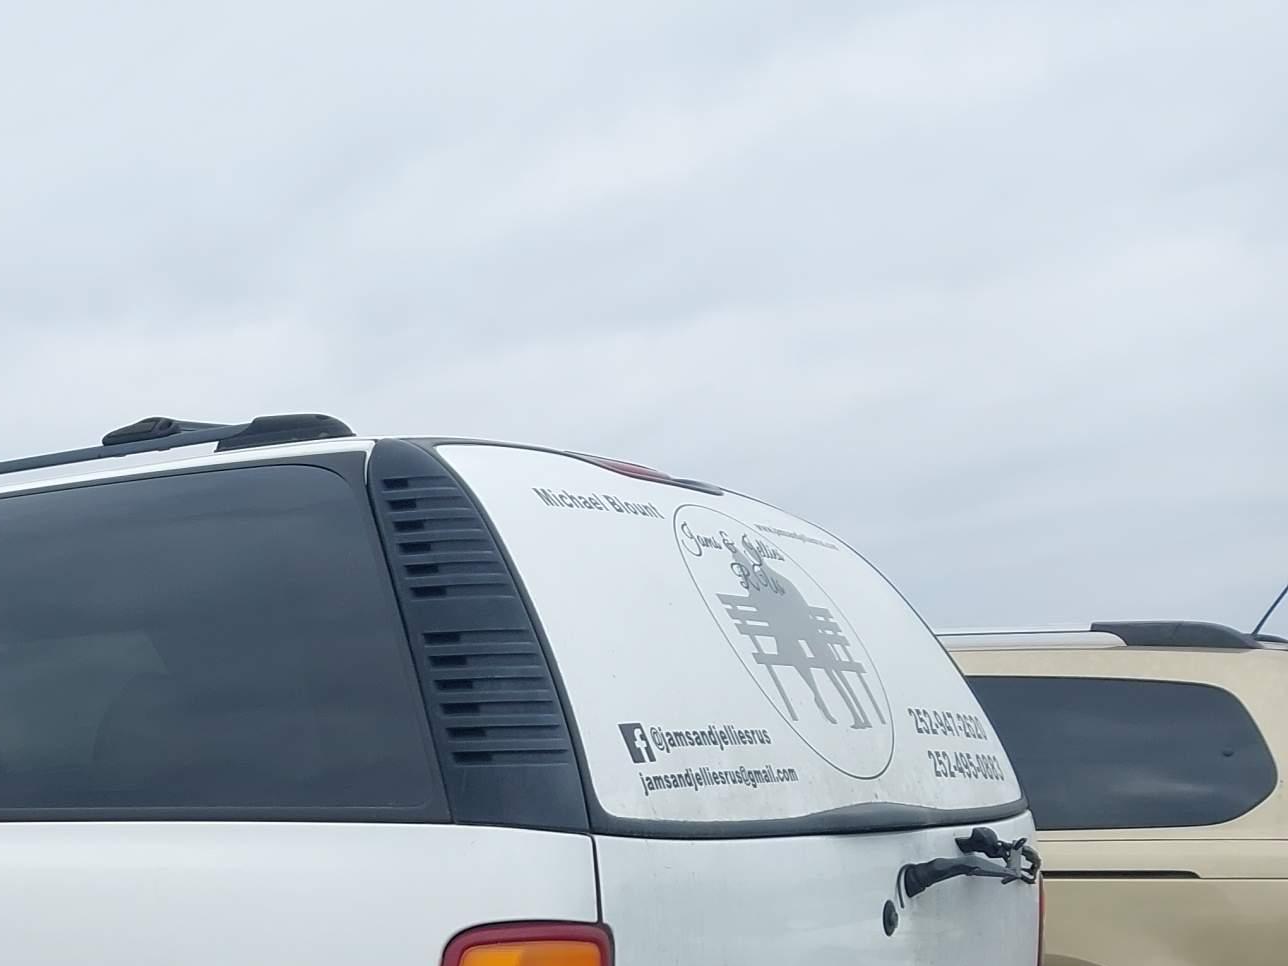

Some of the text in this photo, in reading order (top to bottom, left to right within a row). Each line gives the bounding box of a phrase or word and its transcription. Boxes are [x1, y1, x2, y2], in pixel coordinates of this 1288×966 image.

[532, 488, 665, 519] Michael Blount
[681, 521, 723, 557] Jams
[650, 725, 772, 753] @jamsandjelliesrus
[907, 707, 988, 741] 252-947-2620
[639, 764, 799, 797] jamsandjelliesrus@gmail.com
[927, 750, 1005, 781] 252-495-0883
